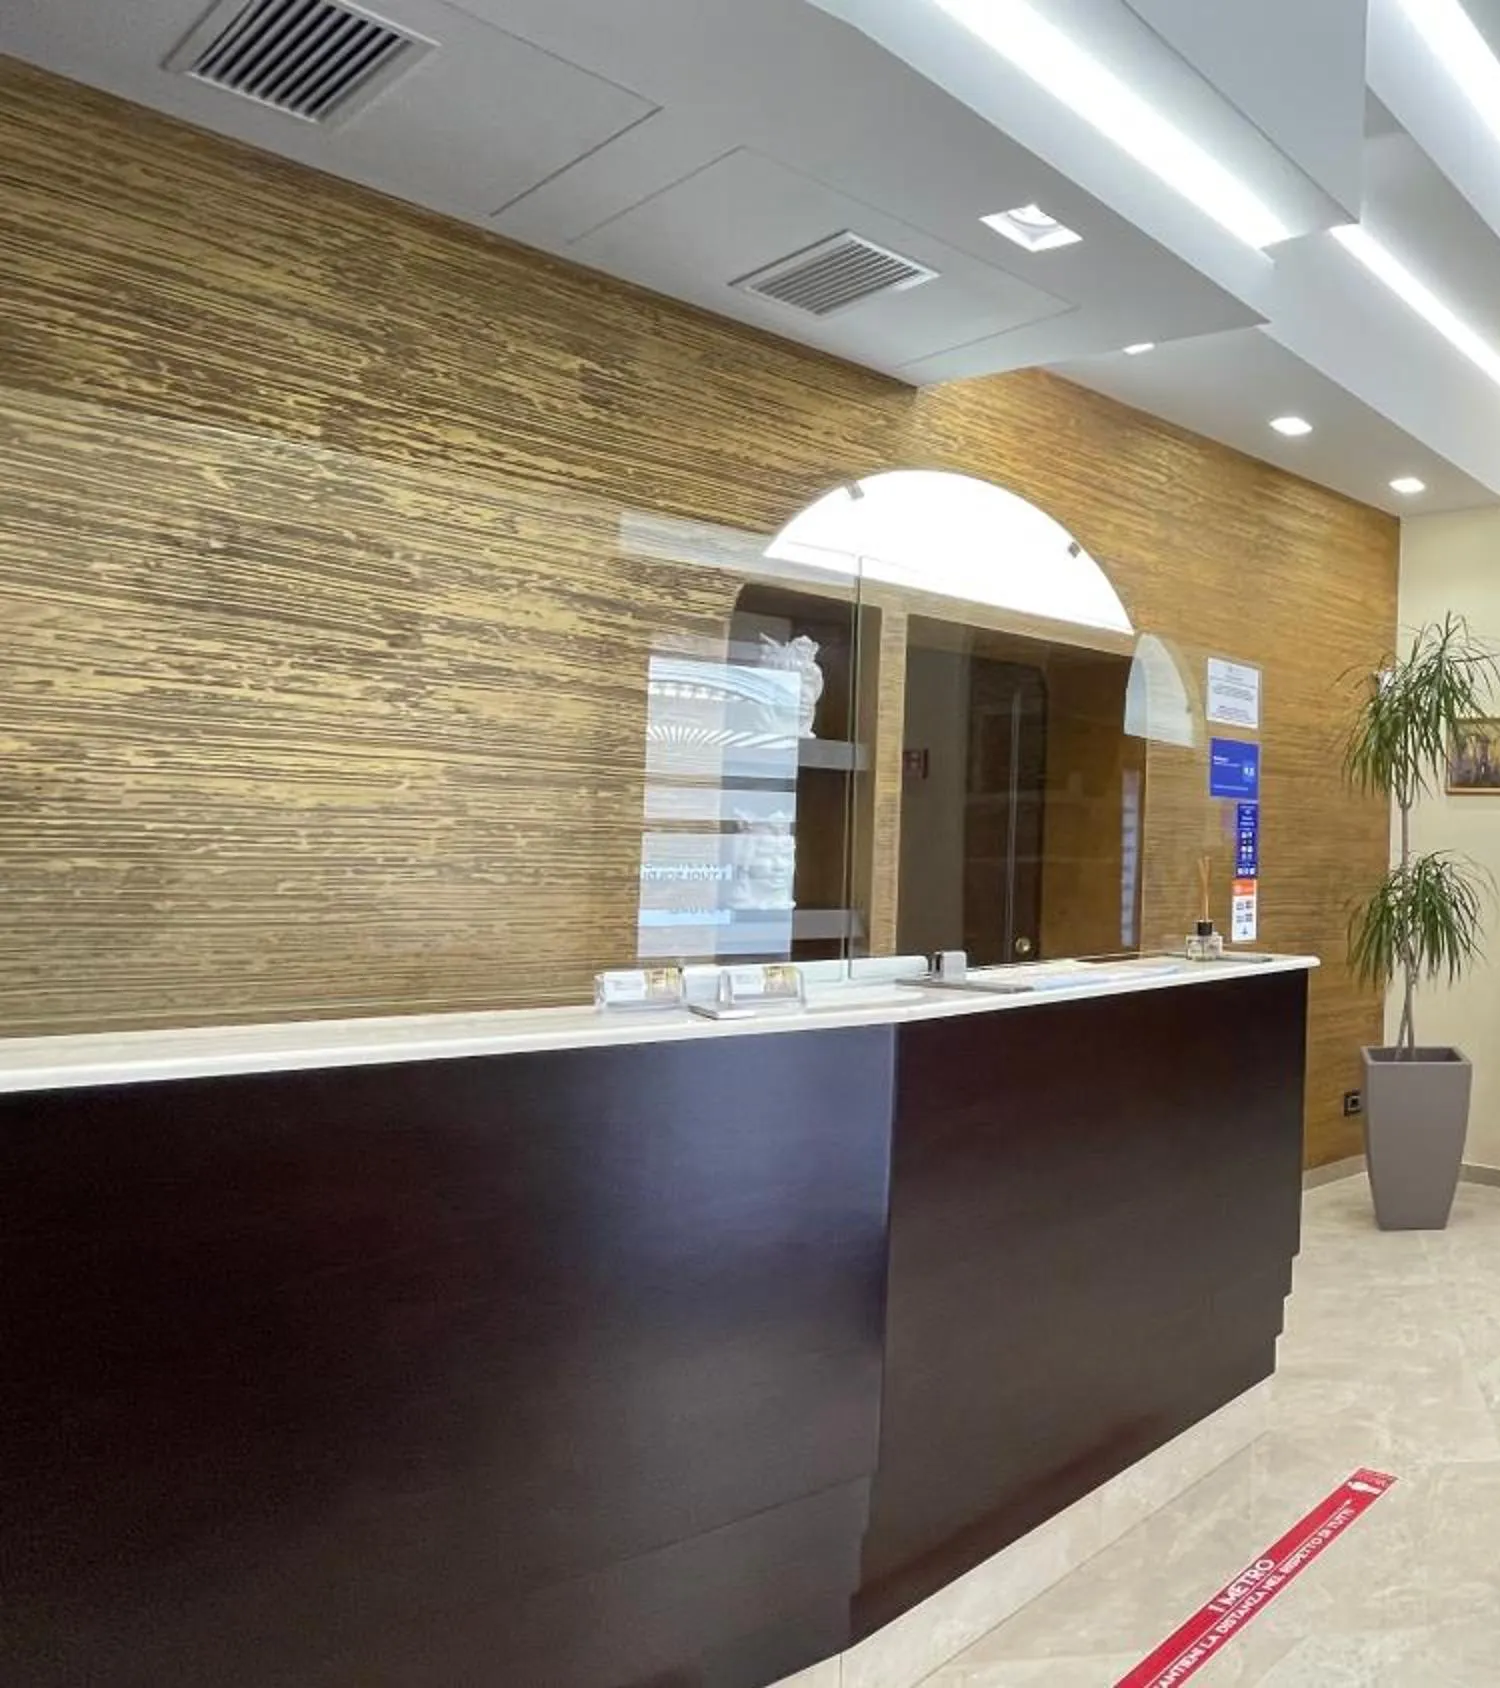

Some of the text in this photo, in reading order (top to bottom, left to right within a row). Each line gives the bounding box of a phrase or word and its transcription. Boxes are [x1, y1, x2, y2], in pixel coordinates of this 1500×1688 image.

[1151, 1647, 1206, 1688] ANTIENI
[1199, 1635, 1221, 1650] LA
[1215, 1591, 1269, 1634] DISTANZA
[1261, 1572, 1287, 1592] NEL
[1279, 1537, 1323, 1575] RISPETTO
[1217, 1559, 1275, 1605] METRO
